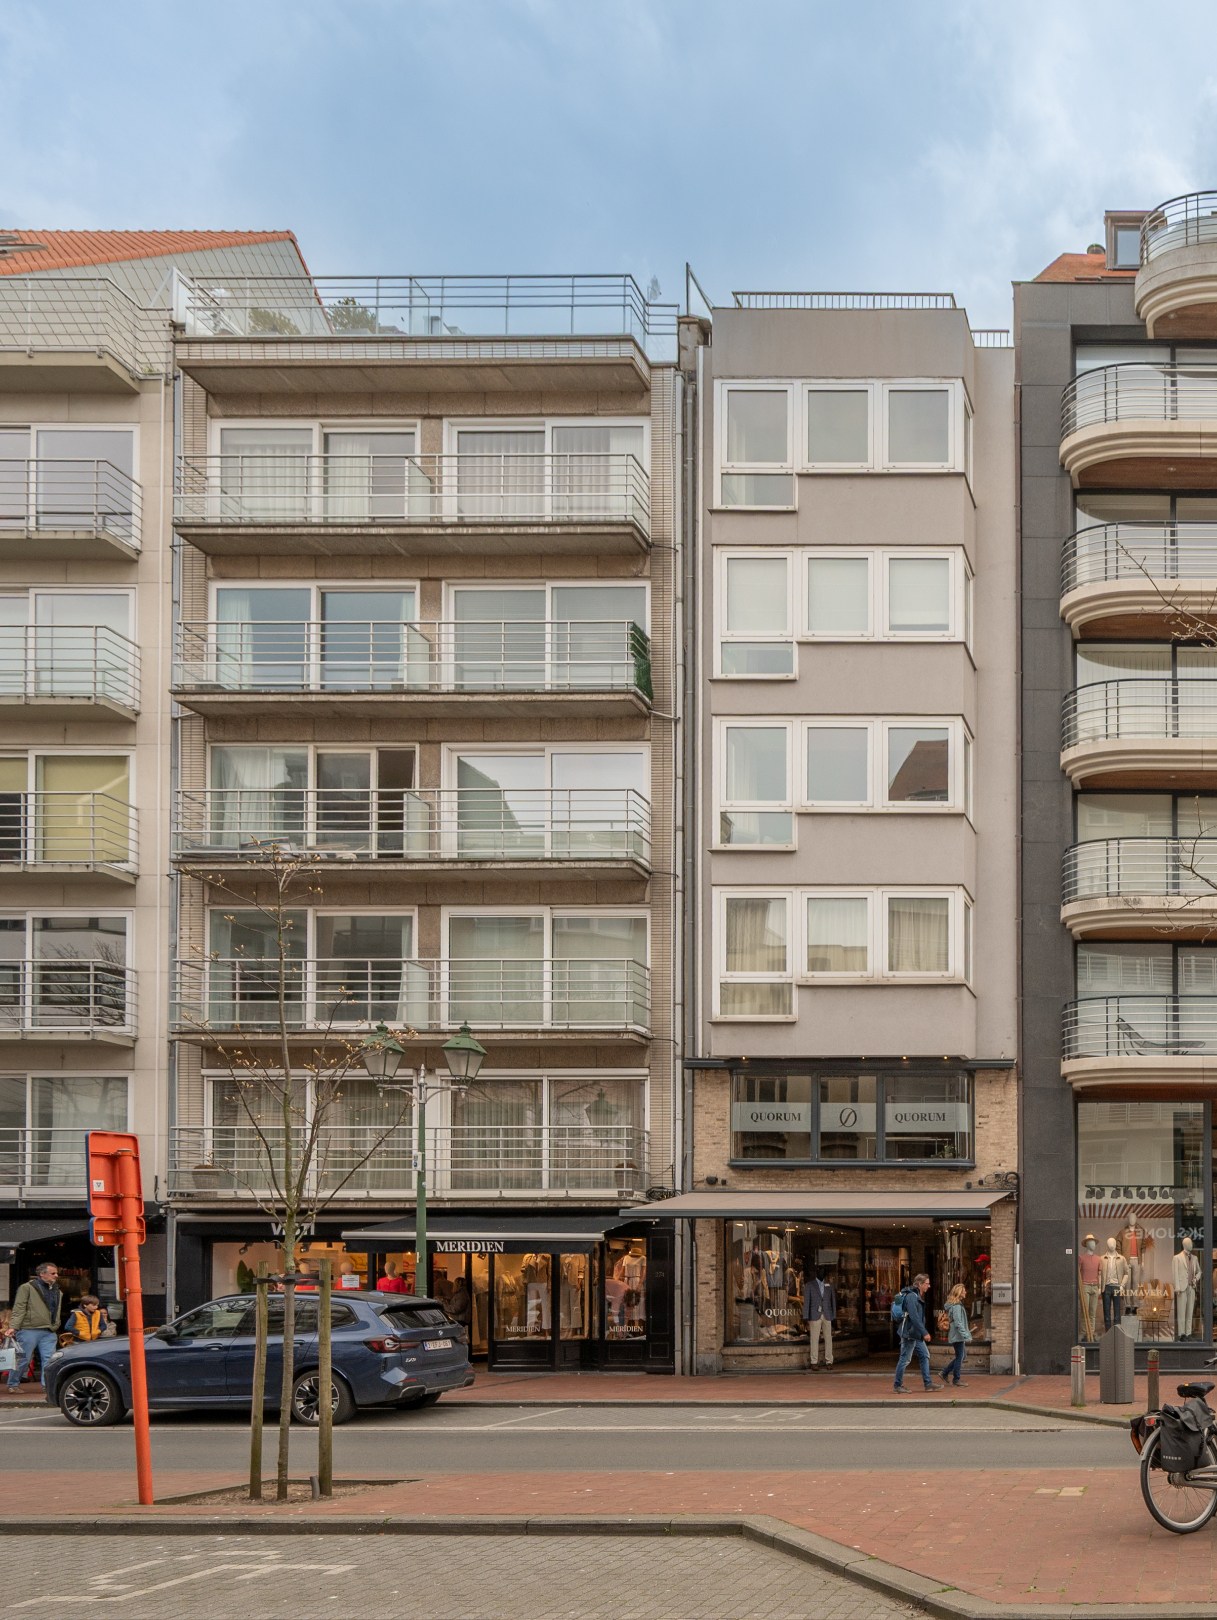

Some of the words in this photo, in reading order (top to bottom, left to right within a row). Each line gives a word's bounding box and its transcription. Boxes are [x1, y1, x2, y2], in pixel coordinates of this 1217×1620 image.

[750, 1112, 802, 1122] QUORUM
[894, 1112, 946, 1122] QUORUM
[435, 1240, 505, 1253] MERIDIEN
[1113, 1289, 1169, 1297] PRIMAVERA
[506, 1325, 541, 1333] MERIDIEN
[609, 1325, 644, 1333] MERIDIEN
